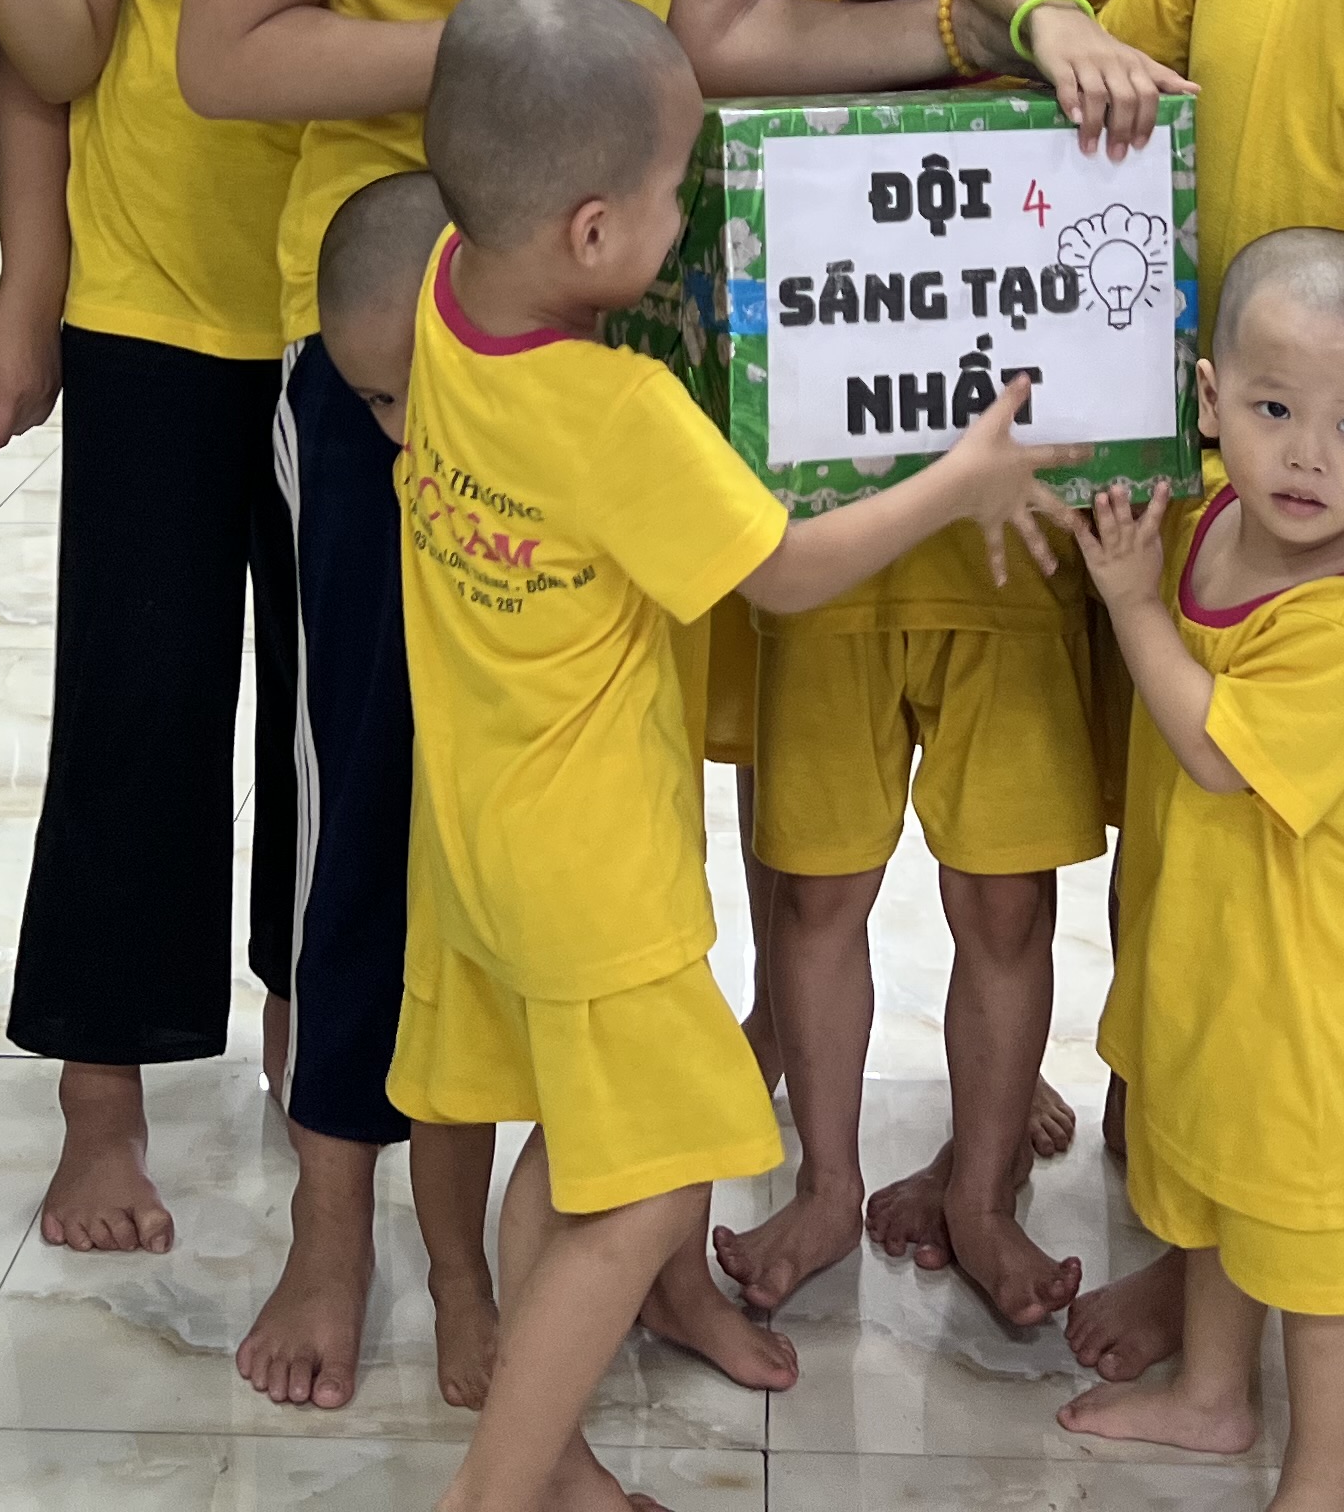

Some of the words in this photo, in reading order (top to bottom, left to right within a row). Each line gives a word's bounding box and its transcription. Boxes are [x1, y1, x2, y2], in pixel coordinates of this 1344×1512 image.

[868, 153, 992, 237] ĐỘI
[1022, 179, 1052, 228] 4
[961, 263, 1081, 331] TẠO
[845, 333, 1043, 436] NHẤT
